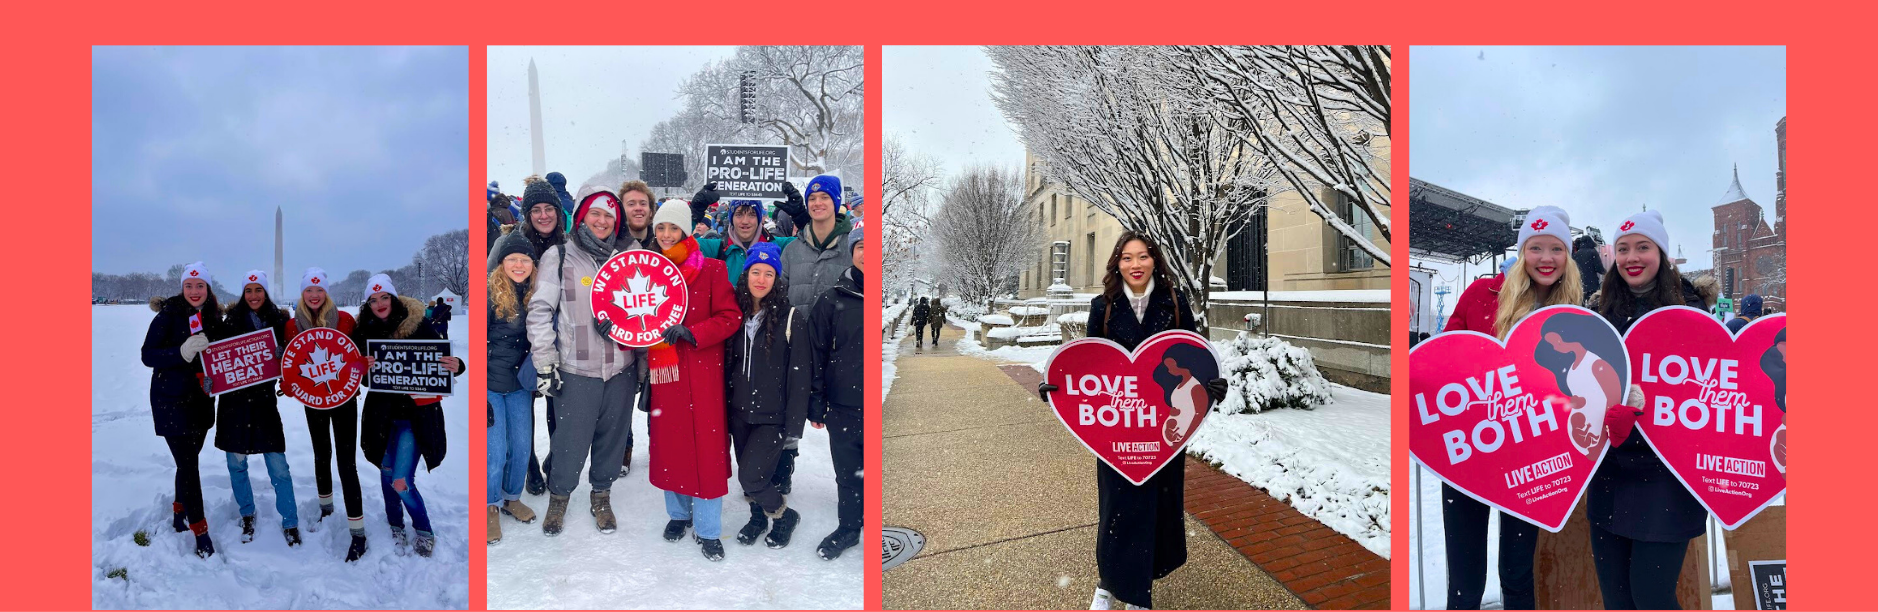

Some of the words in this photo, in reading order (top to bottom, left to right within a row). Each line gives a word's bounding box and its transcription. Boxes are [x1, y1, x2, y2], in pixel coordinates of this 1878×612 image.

[713, 156, 717, 164] I
[723, 156, 746, 165] AM
[753, 157, 780, 166] THE
[708, 167, 785, 180] PRO-LIFE
[594, 271, 611, 292] WE
[610, 254, 660, 272] STAND
[663, 266, 682, 287] ON
[623, 293, 656, 309] LIFE
[597, 310, 633, 341] GARD
[637, 328, 661, 342] FOR
[660, 304, 683, 330] THEE
[212, 350, 231, 362] LET
[235, 341, 267, 355] THEIR
[284, 350, 296, 368] WE
[294, 331, 333, 350] STAND
[337, 337, 355, 354] ON
[374, 351, 378, 359] I
[385, 352, 407, 360] AM
[414, 352, 443, 361] THE
[211, 349, 273, 375] HEARTS
[308, 361, 337, 378] LIFE
[371, 361, 449, 376] PRO-LIFE
[1642, 353, 1738, 390] LOVE
[225, 364, 264, 384] BEAT
[373, 375, 447, 387] GENERATION
[1065, 374, 1138, 398] LOVE
[1415, 364, 1522, 426] LOVE
[1682, 379, 1751, 407] them
[325, 390, 347, 405] FOR
[1098, 390, 1148, 409] them
[1466, 391, 1538, 420] them
[1079, 404, 1157, 428] BOTH
[1654, 395, 1762, 437] BOTH
[1442, 398, 1559, 466] BOTH
[1112, 442, 1131, 452] LIVE
[1133, 442, 1159, 452] ACTION
[1504, 465, 1534, 489] LIVE
[1534, 454, 1572, 478] ACTION
[1696, 453, 1723, 472] LIVE
[1725, 458, 1764, 476] ACTION
[1516, 490, 1530, 499] Text
[1531, 484, 1544, 494] LIFE
[1552, 475, 1572, 487] 70723
[1702, 476, 1715, 484] Text
[1739, 481, 1759, 490] 70723
[1715, 487, 1752, 498] LiveActionOrg
[1532, 487, 1568, 502] LiveActionOrg
